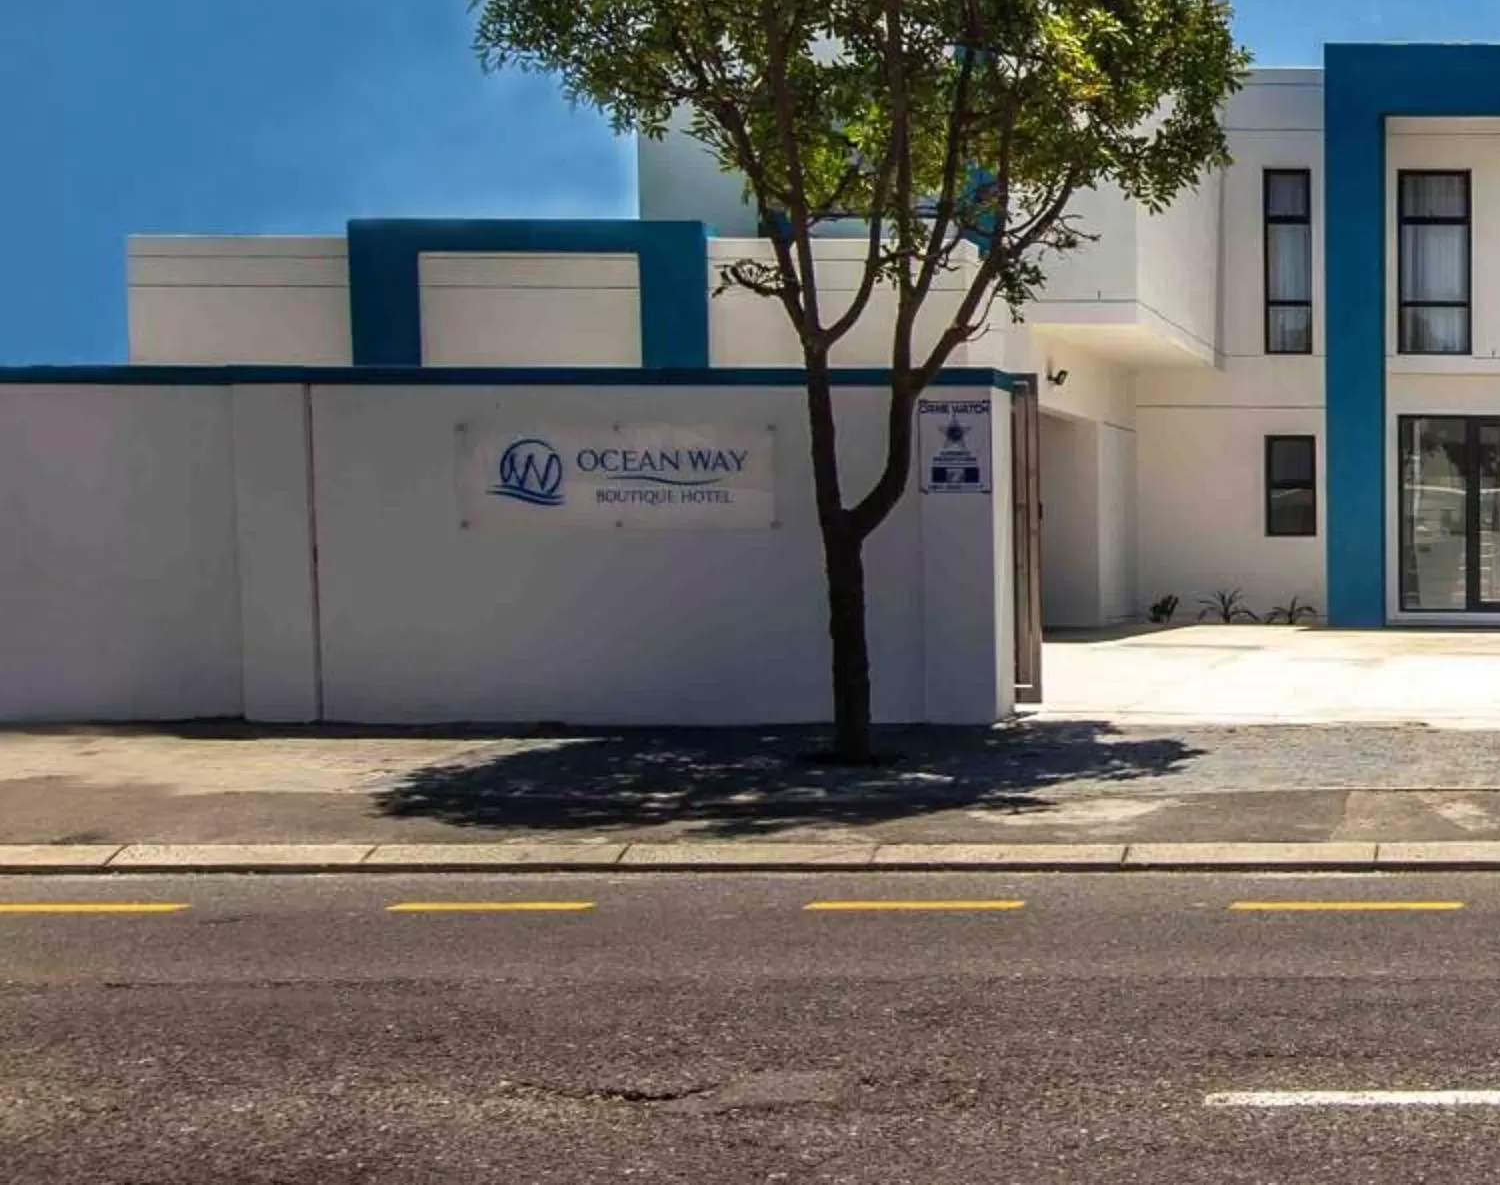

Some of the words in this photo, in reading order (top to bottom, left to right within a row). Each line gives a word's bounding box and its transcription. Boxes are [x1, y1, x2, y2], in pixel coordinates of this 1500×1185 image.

[575, 448, 681, 472] OCEAN
[687, 449, 749, 472] WAY
[595, 489, 675, 505] BOUTIQUE
[681, 489, 735, 504] HOTEL
